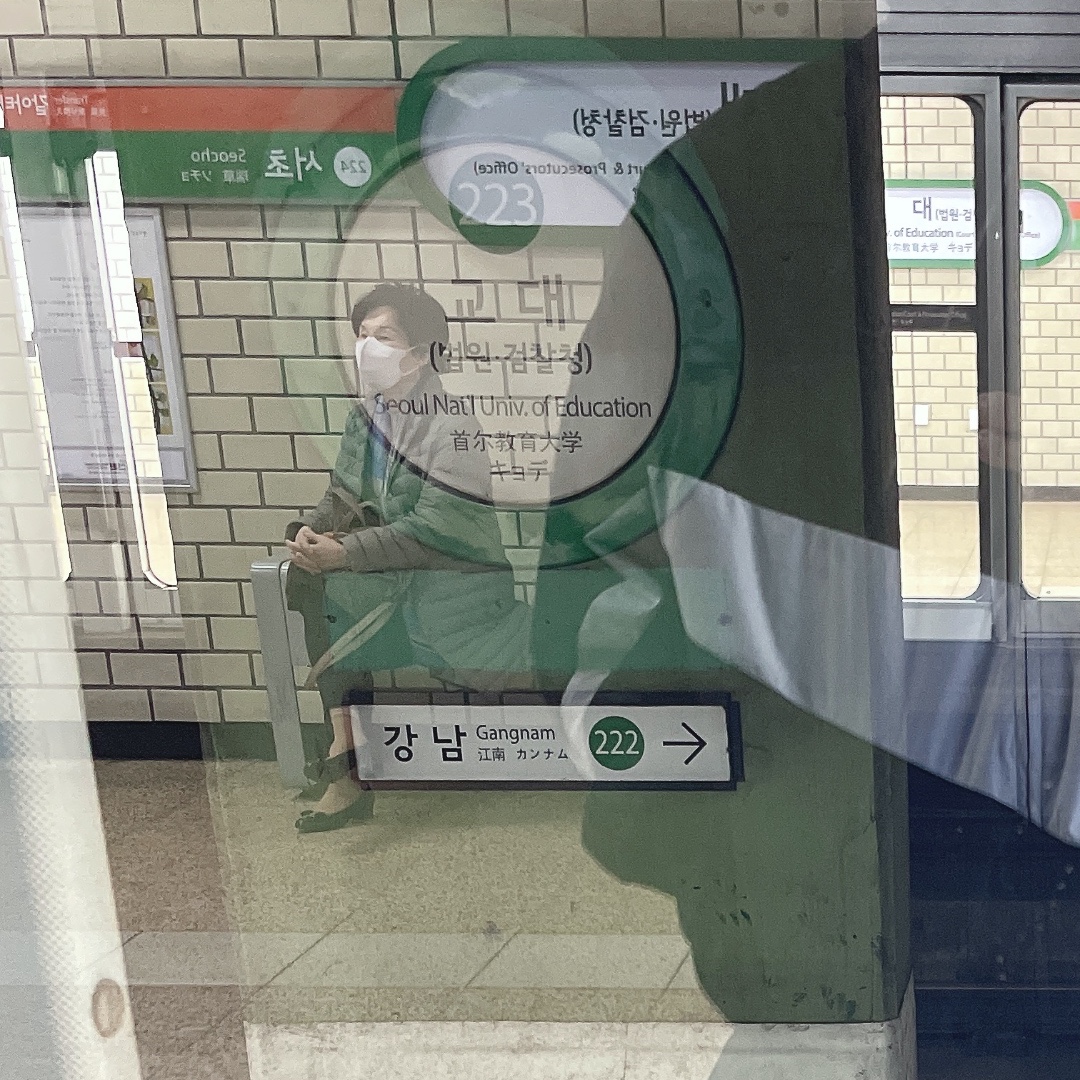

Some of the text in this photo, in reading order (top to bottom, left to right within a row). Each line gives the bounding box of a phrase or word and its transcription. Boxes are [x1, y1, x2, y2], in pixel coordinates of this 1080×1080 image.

[458, 182, 537, 226] 223
[894, 227, 904, 238] of
[905, 227, 954, 238] Education
[430, 341, 593, 375] (법원·검찰청)
[433, 393, 476, 416] Nat'l
[479, 395, 529, 417] Univ.
[532, 395, 550, 417] of
[555, 395, 652, 418] Education
[450, 430, 583, 454] 首尔教育大学
[489, 459, 549, 482] キョデ
[476, 724, 556, 743] Gangnam
[594, 729, 640, 756] 222
[477, 746, 569, 762] 江南 カンナム
